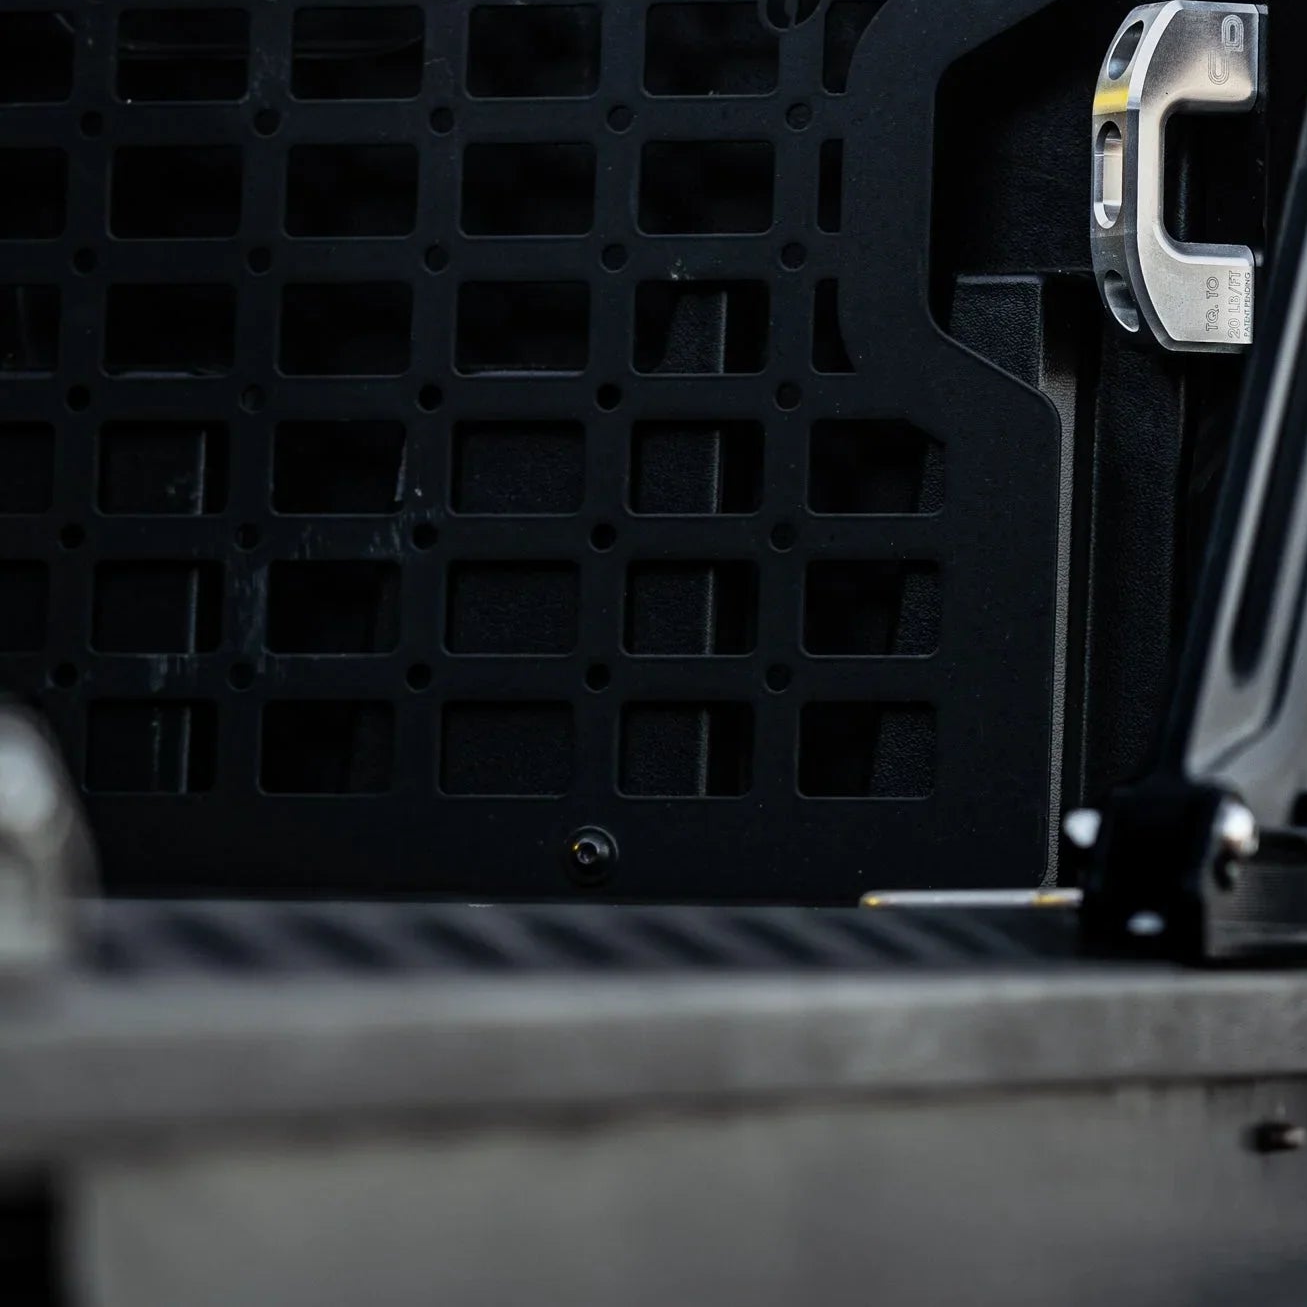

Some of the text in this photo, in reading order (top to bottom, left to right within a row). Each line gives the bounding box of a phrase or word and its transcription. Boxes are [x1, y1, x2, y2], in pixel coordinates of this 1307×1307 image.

[1206, 276, 1219, 331] TQ. TO
[1228, 270, 1242, 339] 20 LB/FT
[1243, 310, 1251, 337] PATENT
